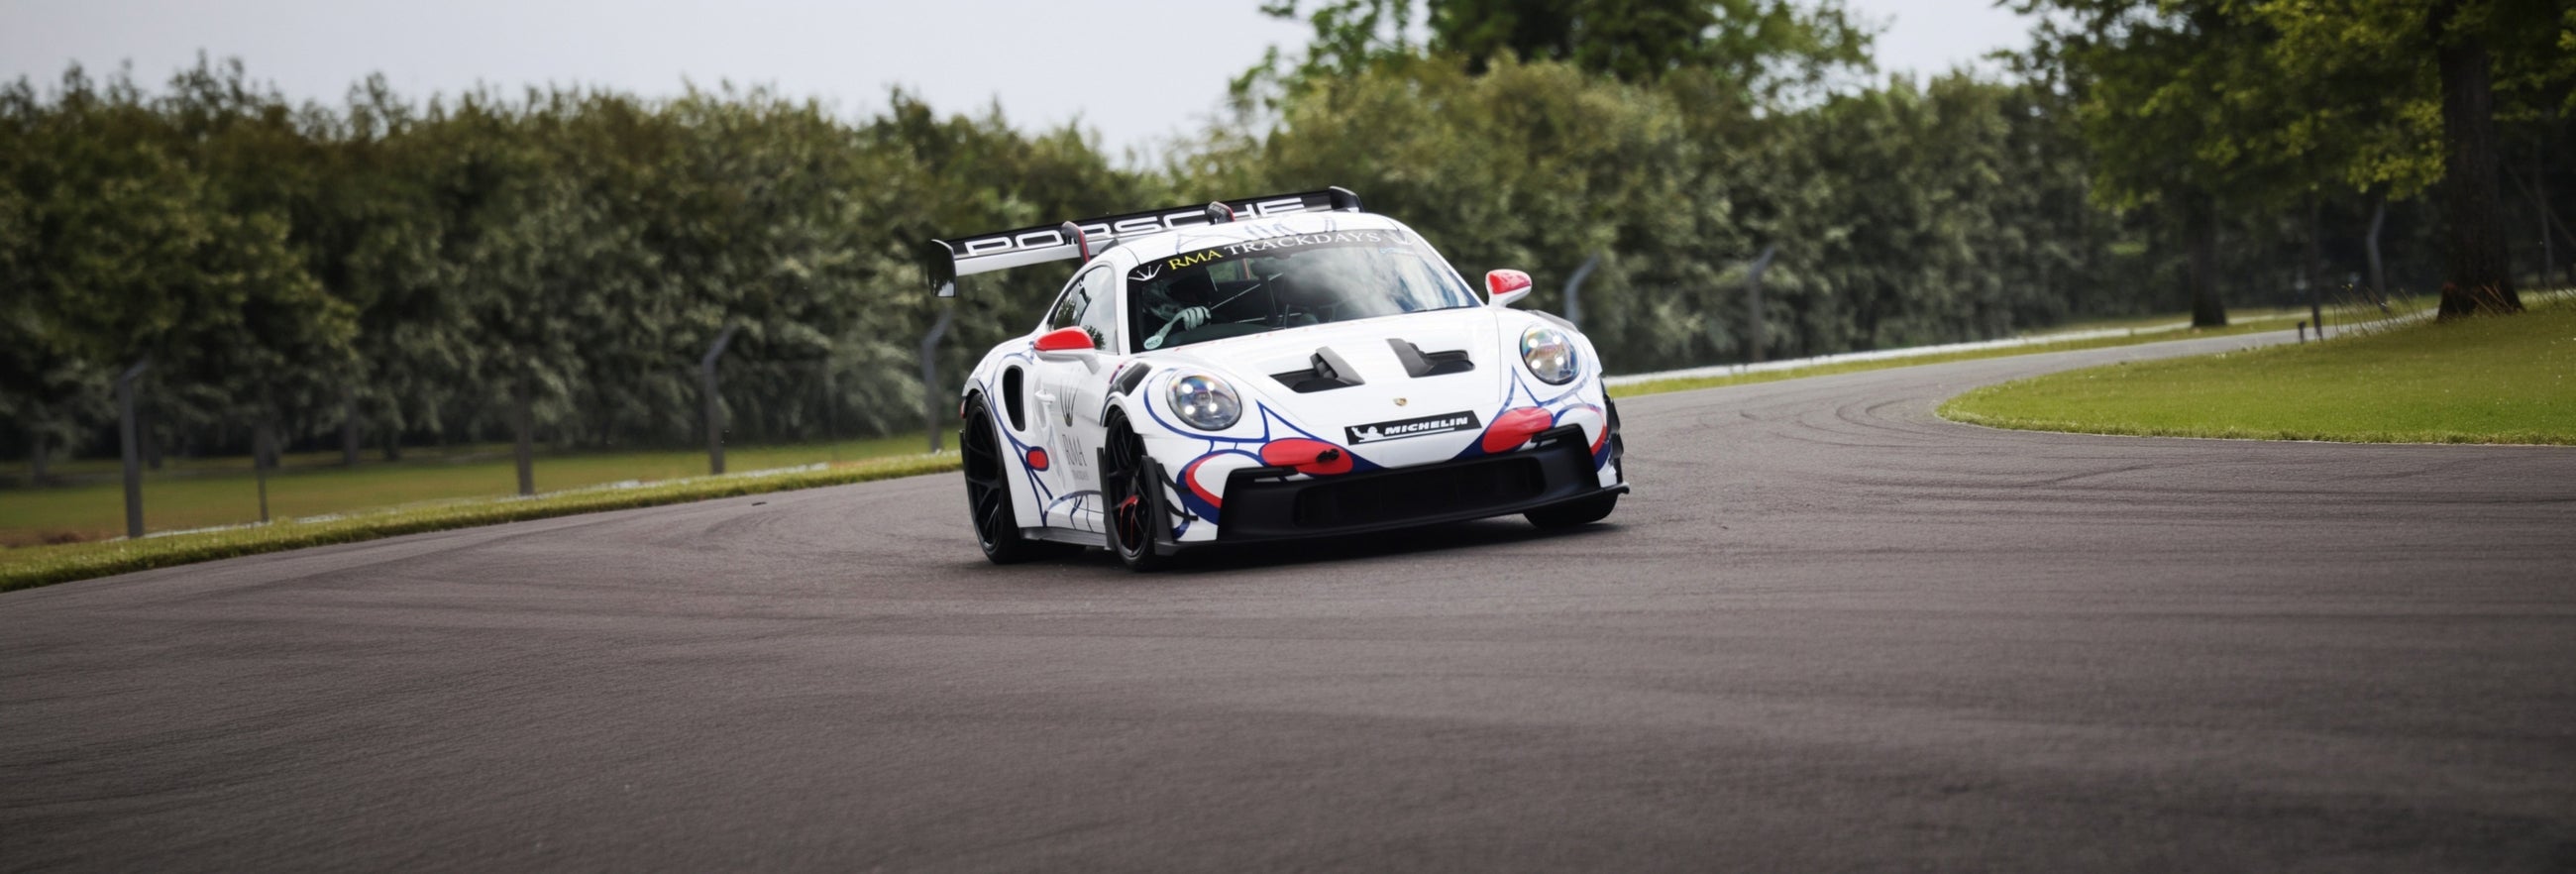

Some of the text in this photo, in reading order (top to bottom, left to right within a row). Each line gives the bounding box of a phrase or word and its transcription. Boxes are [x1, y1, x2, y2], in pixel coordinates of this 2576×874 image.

[1169, 231, 1381, 270] RMA TRACKDAYS
[1385, 416, 1468, 435] MICHELIN
[1062, 434, 1087, 466] RMA
